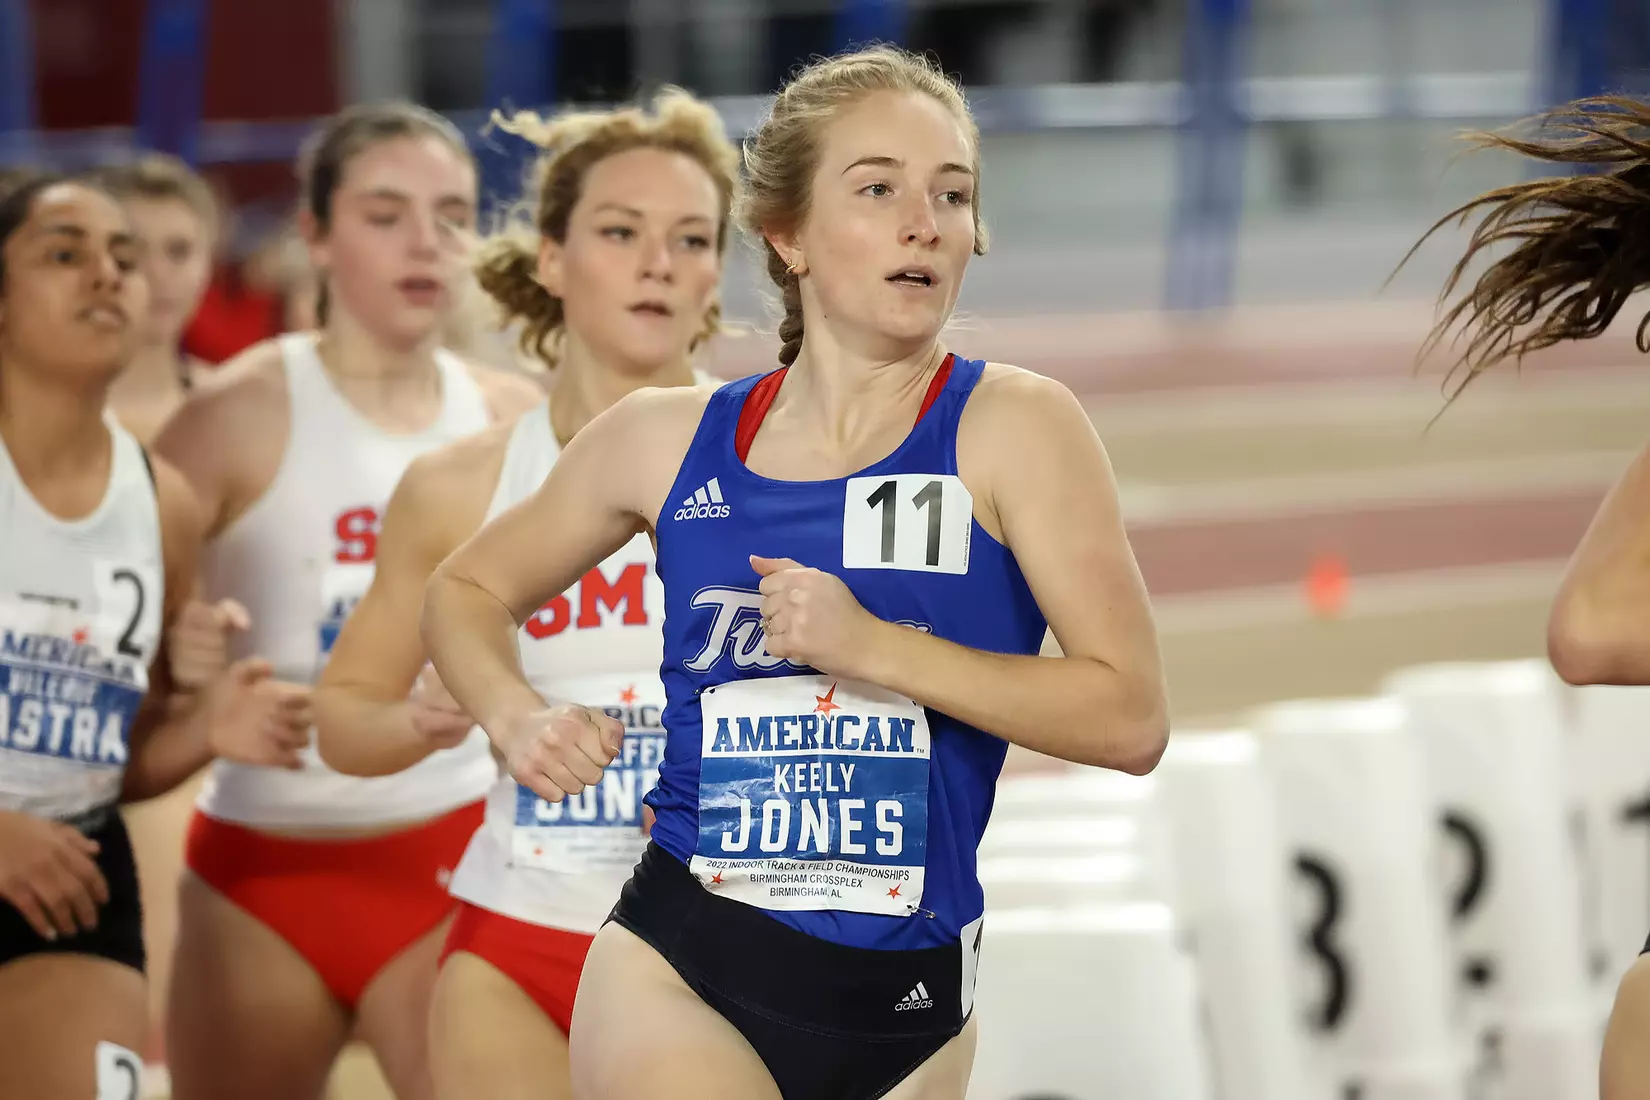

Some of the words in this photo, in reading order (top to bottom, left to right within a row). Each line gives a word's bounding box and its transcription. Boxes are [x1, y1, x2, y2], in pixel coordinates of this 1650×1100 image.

[673, 502, 731, 521] adidas
[866, 481, 943, 566] 11
[113, 568, 144, 657] 2
[711, 714, 915, 752] AMERICAN
[774, 763, 855, 792] KEELY
[720, 798, 903, 856] JONES
[706, 860, 728, 869] 2022
[729, 859, 763, 869] INDOOR
[767, 860, 797, 870] TRACK
[808, 862, 834, 871] FIELD
[835, 862, 910, 881] CHAMPIONSHIPS
[750, 873, 807, 884] BIRMINGHAM
[809, 874, 863, 888] CROSSPLEX
[831, 889, 842, 898] AL
[894, 999, 934, 1012] adidas
